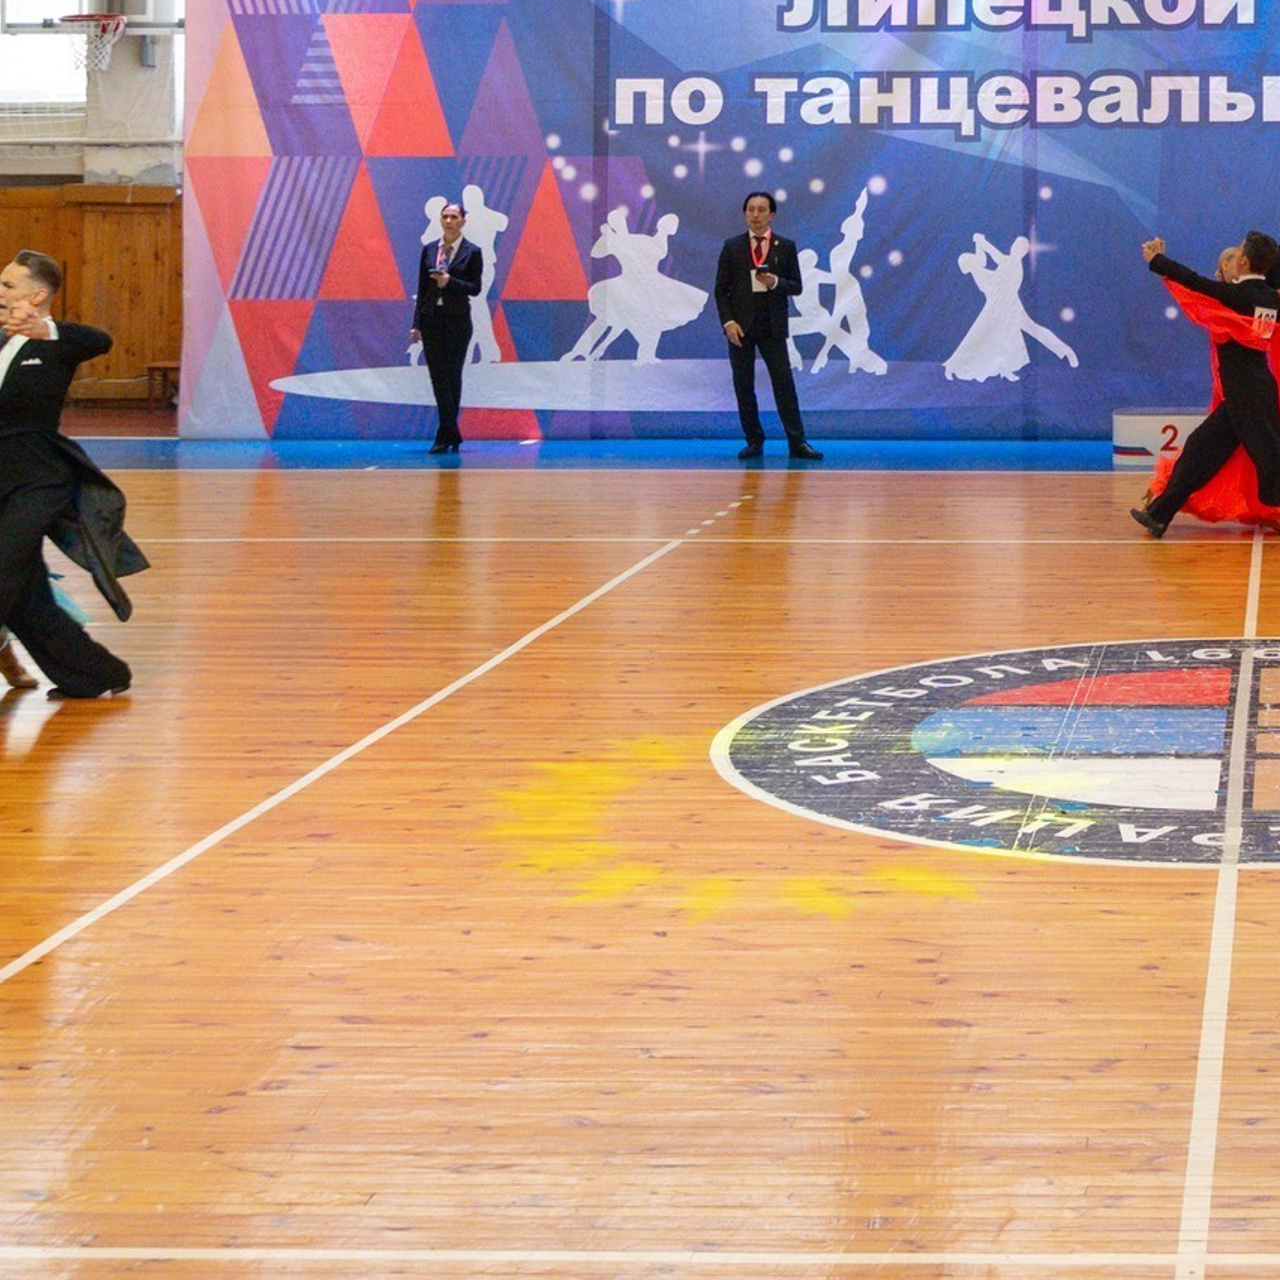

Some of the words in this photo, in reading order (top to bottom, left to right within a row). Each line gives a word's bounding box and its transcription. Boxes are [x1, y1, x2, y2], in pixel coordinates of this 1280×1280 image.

[612, 74, 725, 127] по
[1159, 424, 1179, 452] 2
[787, 656, 1091, 787] БАСКЕТБОЛА
